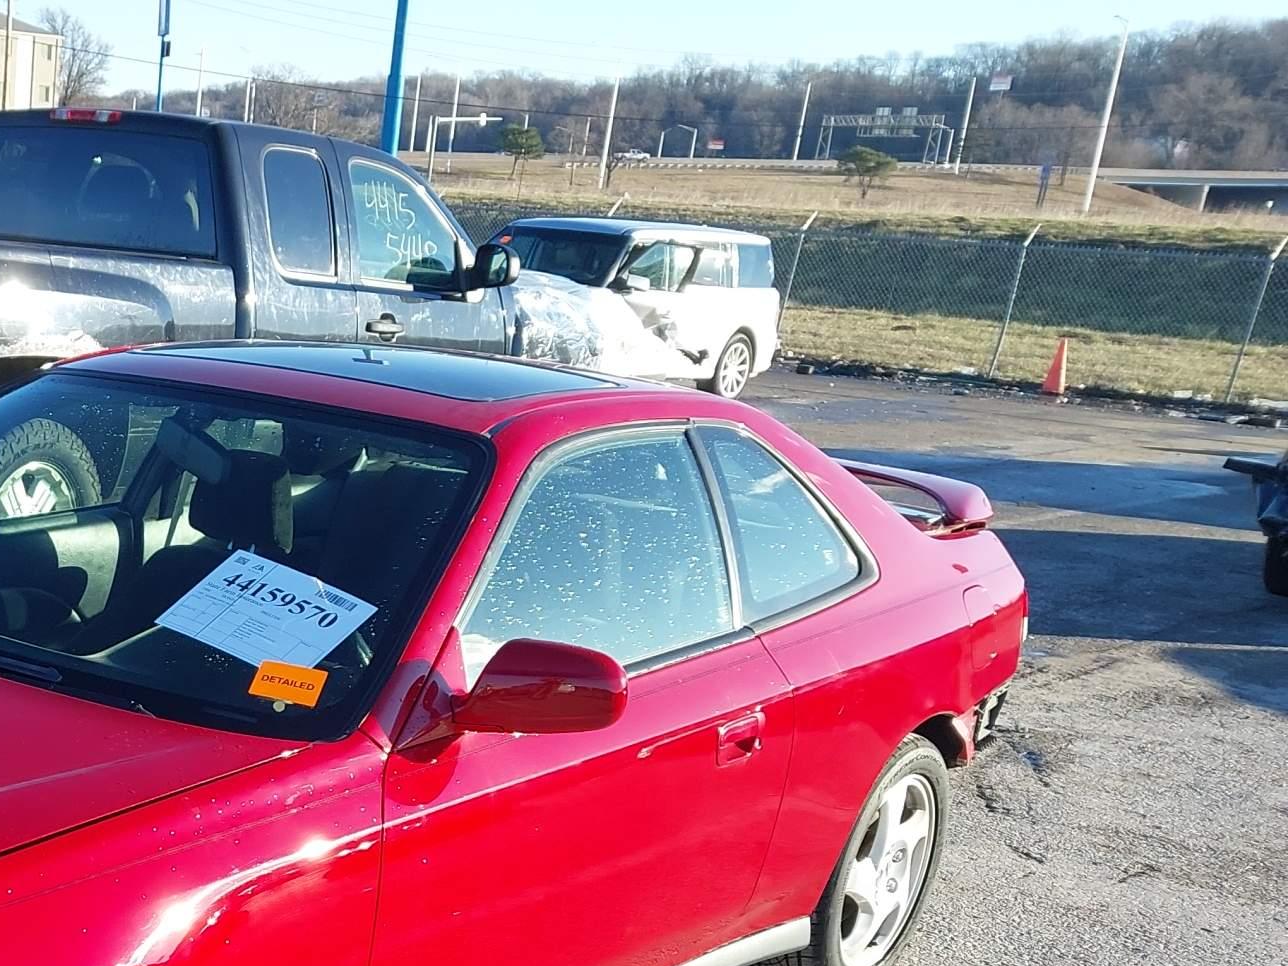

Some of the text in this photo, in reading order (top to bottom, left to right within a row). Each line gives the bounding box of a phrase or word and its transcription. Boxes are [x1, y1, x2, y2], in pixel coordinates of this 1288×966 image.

[363, 179, 416, 231] 4415
[385, 232, 438, 269] 5440
[223, 574, 339, 629] 44159570
[261, 675, 315, 692] DETAILED
